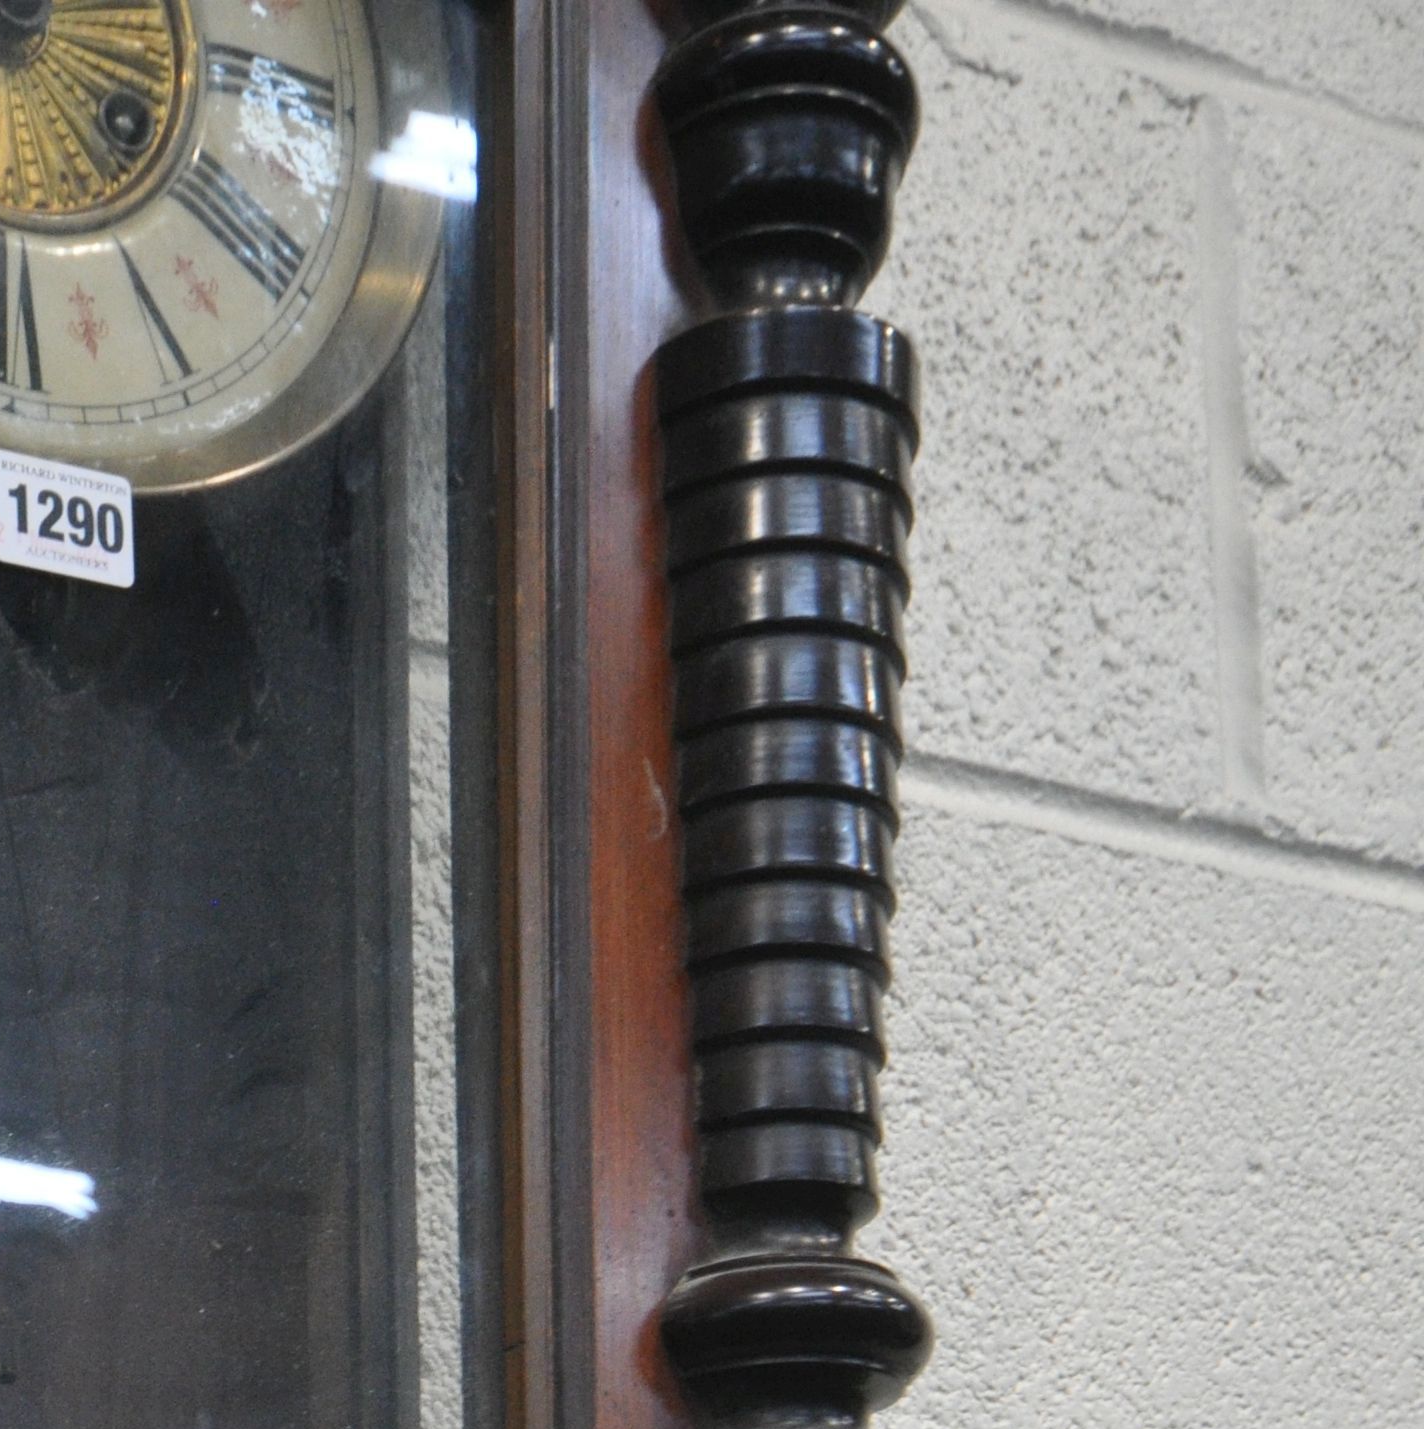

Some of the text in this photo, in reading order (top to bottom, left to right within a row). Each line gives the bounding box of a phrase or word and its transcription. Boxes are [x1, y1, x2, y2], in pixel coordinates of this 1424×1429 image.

[112, 231, 200, 386] V
[1, 459, 127, 496] RICHARD WINTERTON
[8, 483, 124, 554] 1290
[27, 546, 109, 571] AUCTIONEERS
